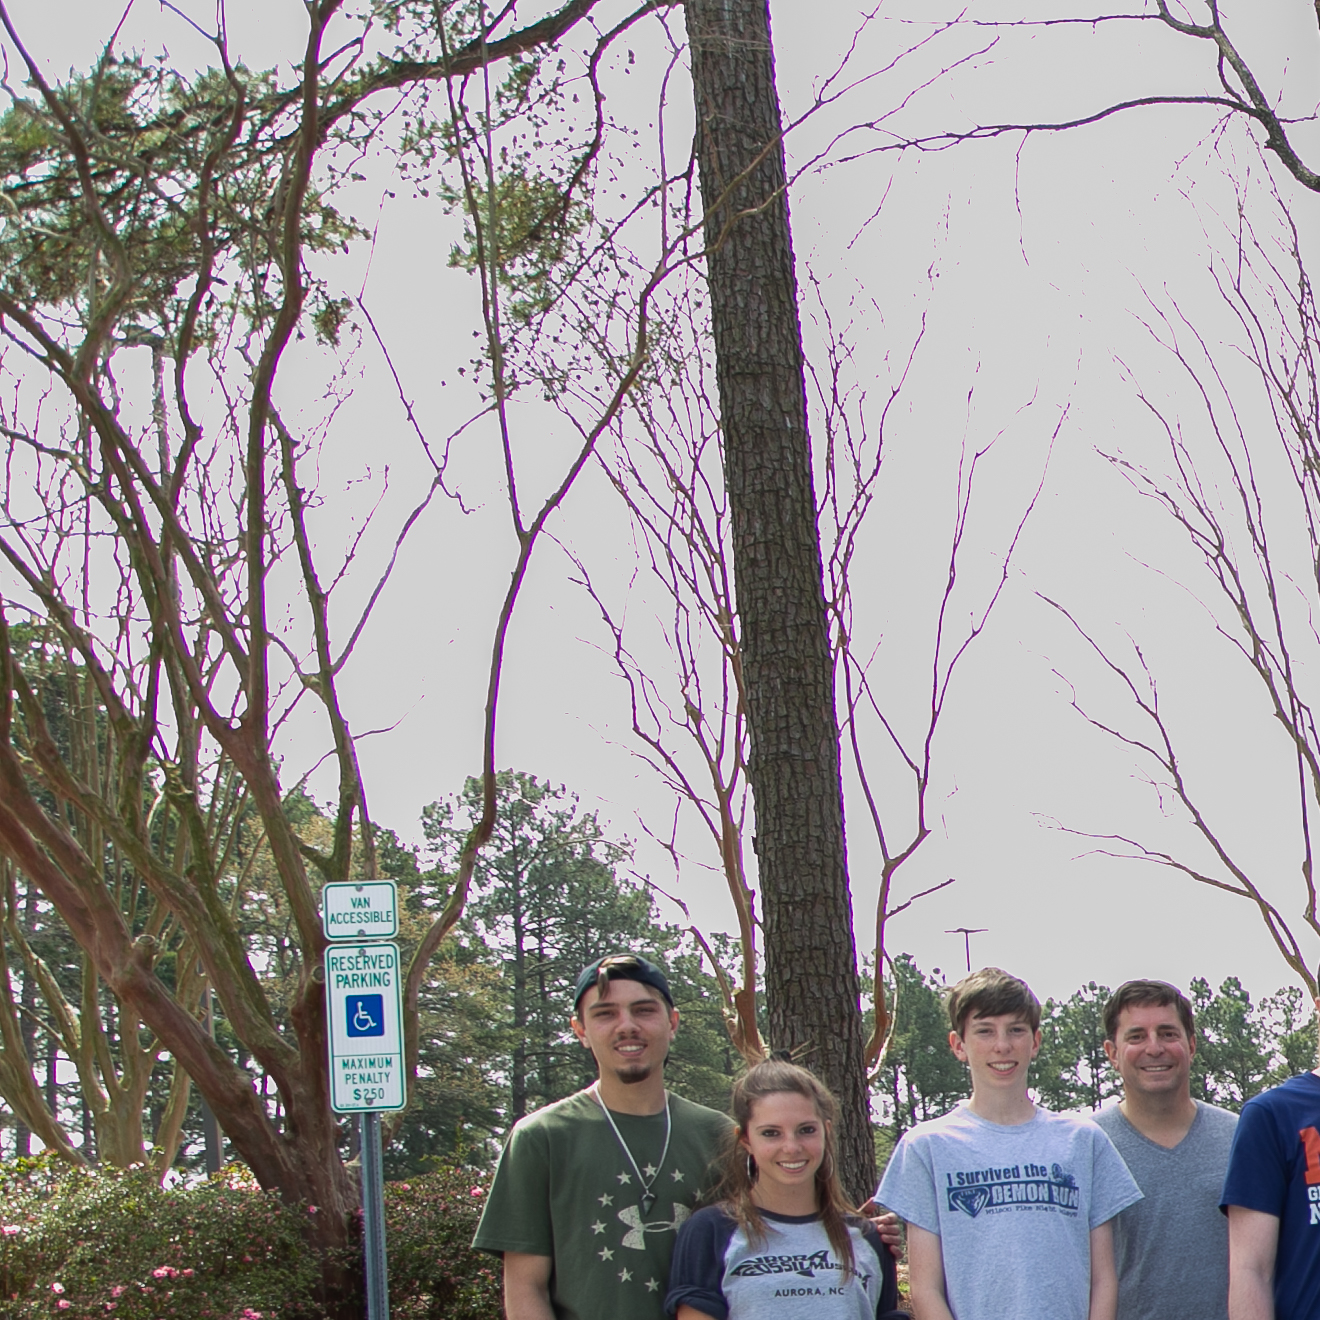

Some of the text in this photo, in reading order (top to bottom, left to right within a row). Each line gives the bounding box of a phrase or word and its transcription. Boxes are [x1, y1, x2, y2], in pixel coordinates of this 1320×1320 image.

[350, 897, 370, 909] VAN
[330, 910, 392, 925] ACCESSIBLE
[331, 954, 394, 971] RESERVED
[336, 972, 391, 989] PARKING
[342, 1057, 393, 1071] MAXIMUM
[345, 1072, 391, 1085] PENALTY
[353, 1088, 385, 1101] $250
[946, 1163, 1047, 1187] I Survived the
[992, 1183, 1079, 1207] DEMON RUN
[774, 1287, 845, 1297] AURORA, NC
